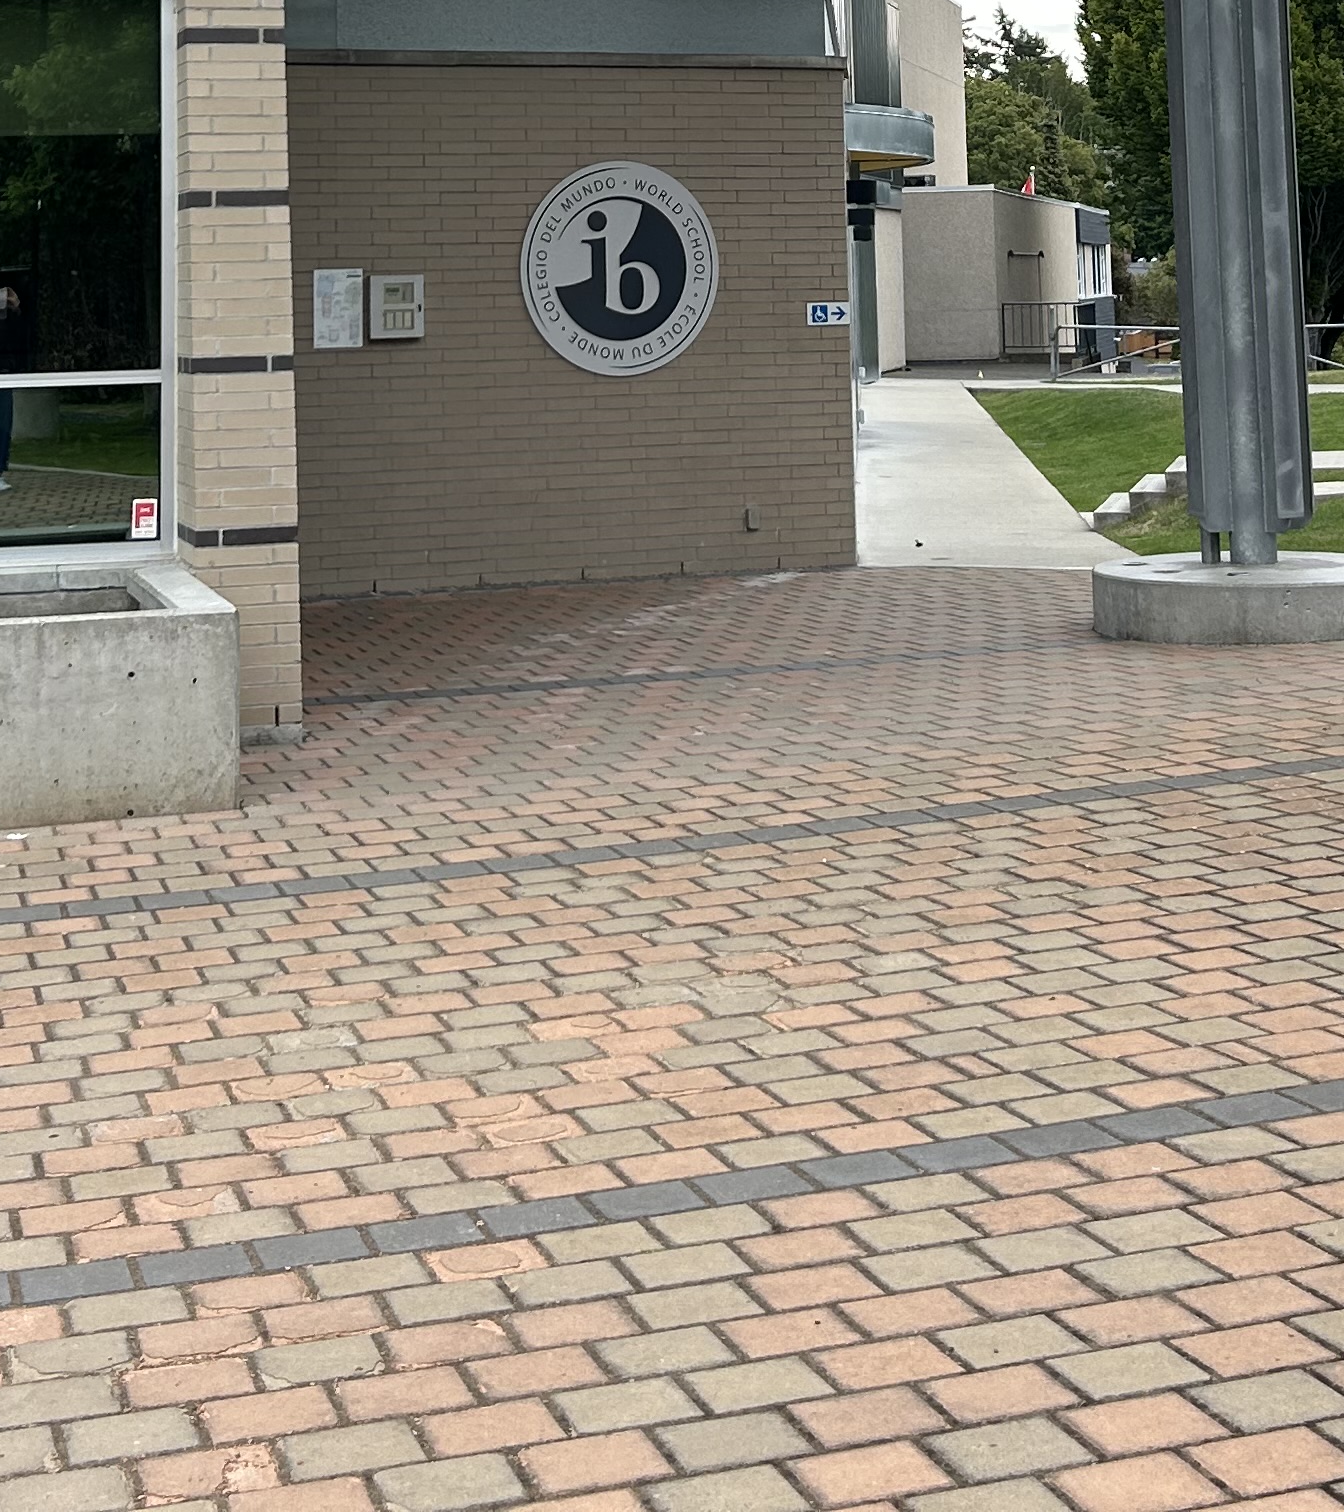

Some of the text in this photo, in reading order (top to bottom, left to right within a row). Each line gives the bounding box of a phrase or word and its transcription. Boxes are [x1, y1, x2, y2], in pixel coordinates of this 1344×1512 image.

[536, 177, 616, 322] COLEGIO DEL MUNDO
[634, 178, 706, 284] WORLD SCHOOL
[568, 330, 625, 361] MONDE
[631, 342, 654, 360] DU
